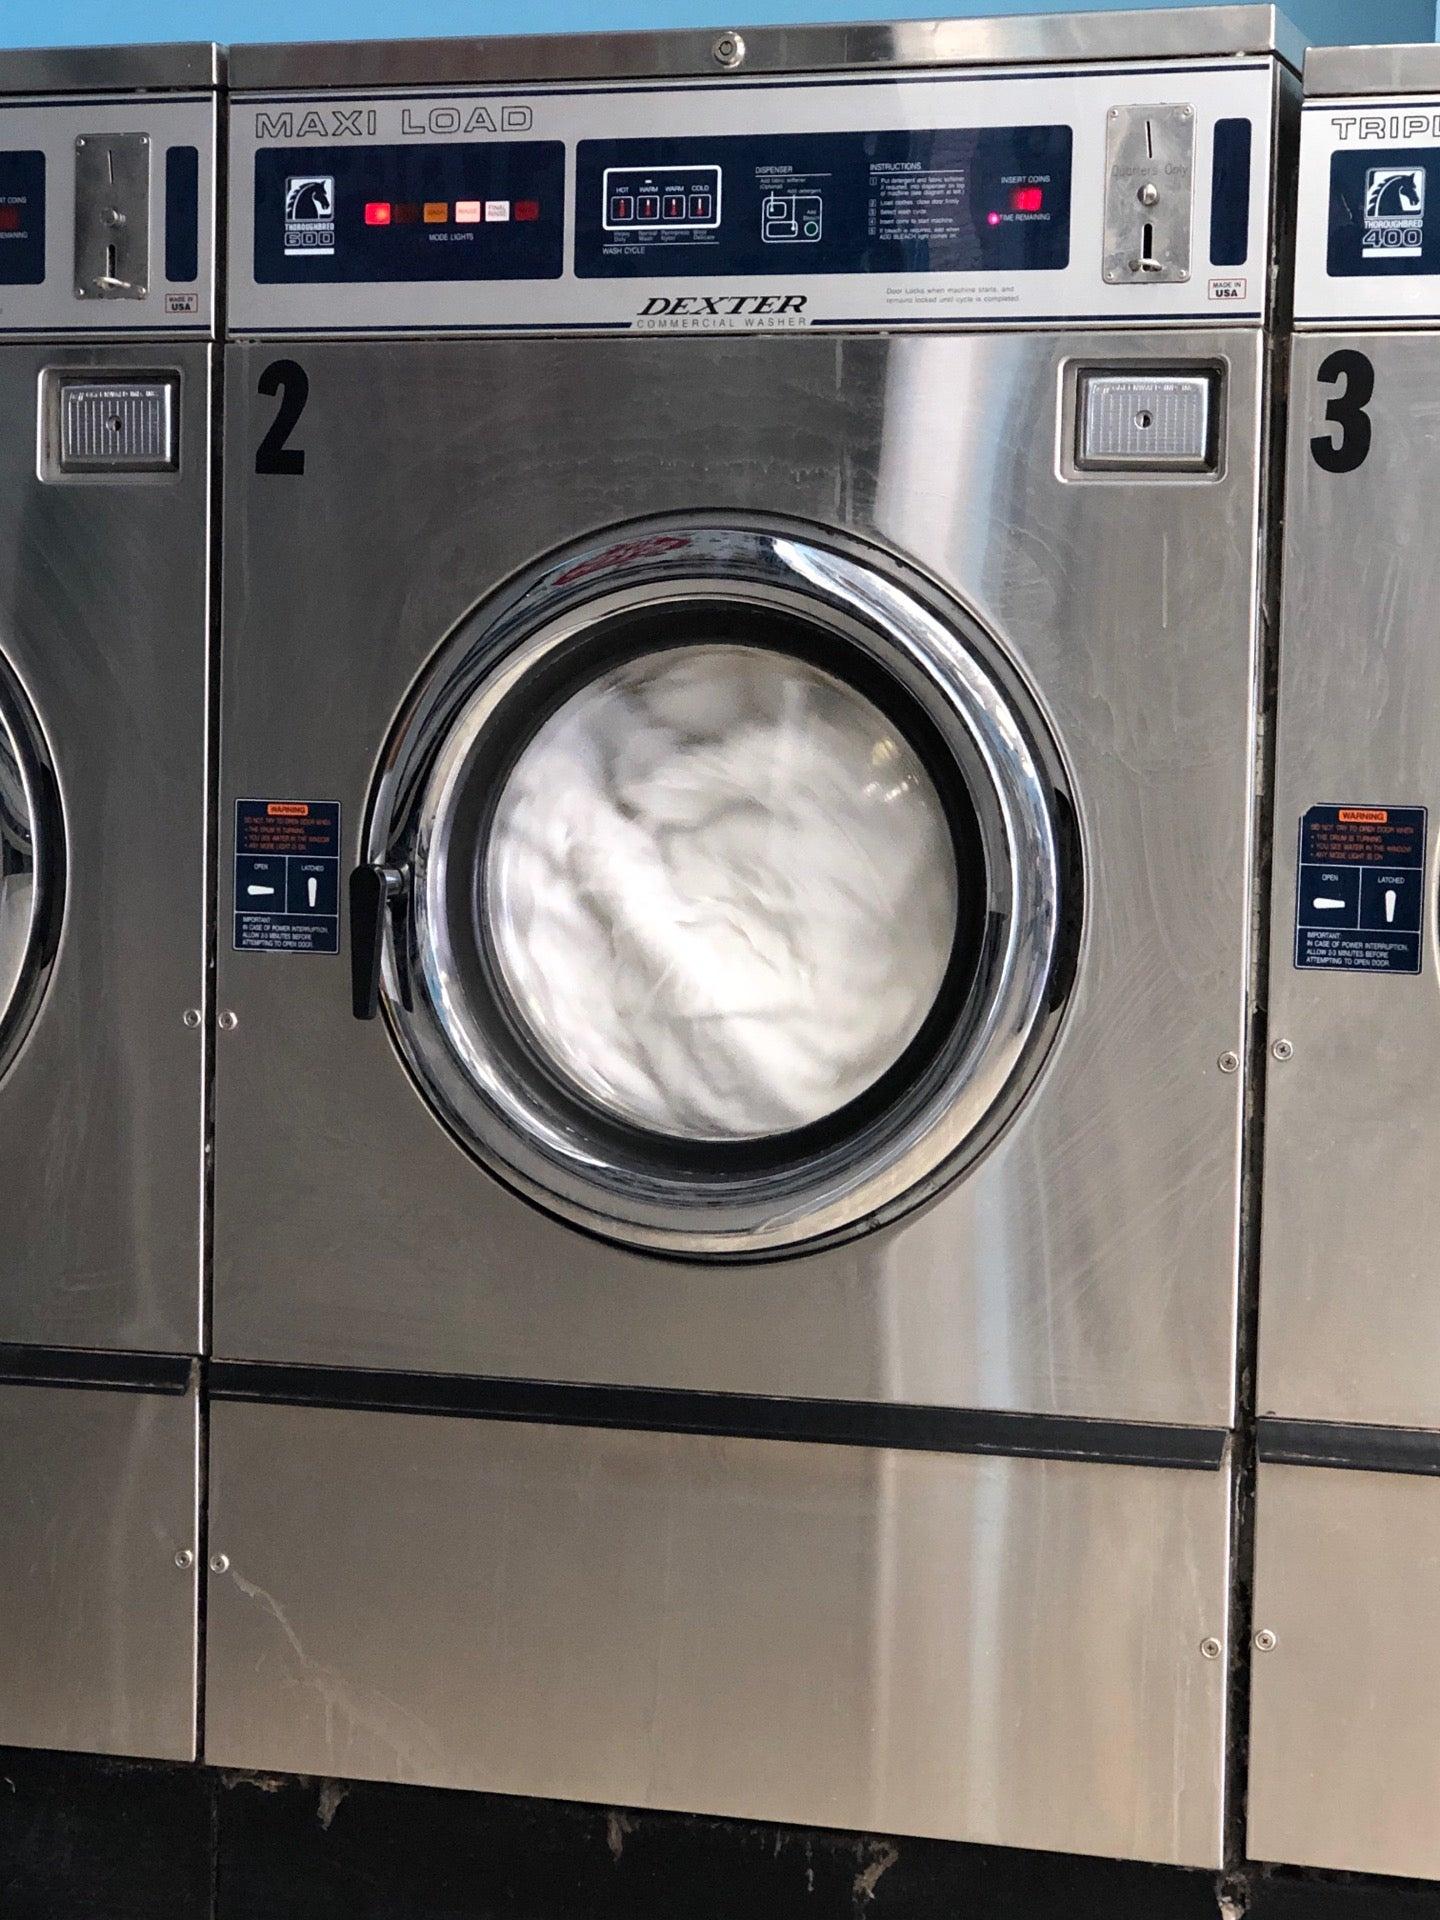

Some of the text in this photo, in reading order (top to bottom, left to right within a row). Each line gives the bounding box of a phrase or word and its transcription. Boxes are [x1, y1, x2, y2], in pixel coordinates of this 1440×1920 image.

[255, 106, 532, 138] MAXI LOAD
[870, 162, 922, 170] INSTRUCTIONS
[1164, 163, 1188, 176] Only
[1015, 213, 1050, 221] REMAINING
[284, 222, 334, 231] THOROUGHBRED
[1364, 220, 1423, 229] THOROUGHBRED
[1362, 228, 1422, 248] 400
[1216, 289, 1238, 297] USA
[637, 295, 808, 316] DEXTER
[637, 317, 806, 329] COMMERCIAL WASHER
[255, 359, 309, 475] 2
[1310, 349, 1374, 473] 3
[1306, 957, 1342, 965] ATTEMPTING
